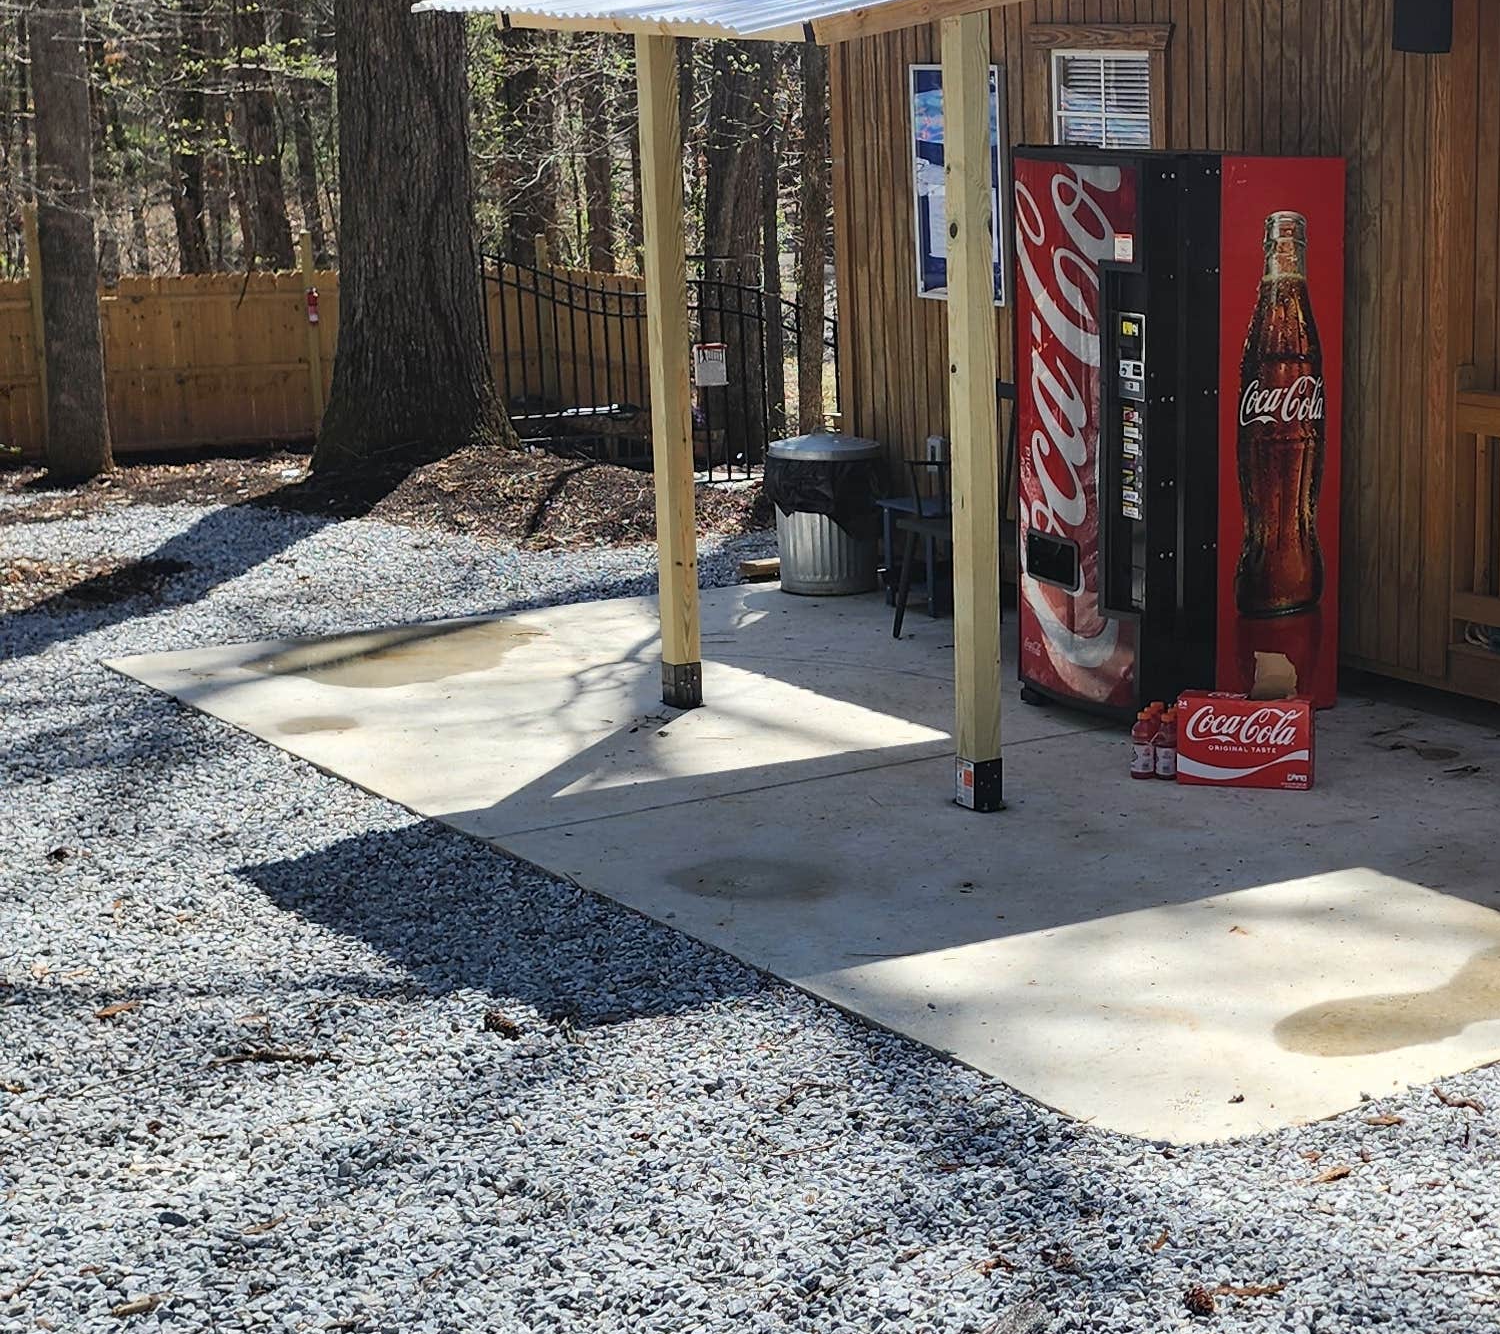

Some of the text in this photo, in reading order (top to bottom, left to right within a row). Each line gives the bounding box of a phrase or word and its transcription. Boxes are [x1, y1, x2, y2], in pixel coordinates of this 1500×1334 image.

[1240, 375, 1324, 426] Coca-Cola
[1185, 705, 1304, 746] Coca-Cola
[1208, 744, 1277, 754] ORIGINAL TASTE
